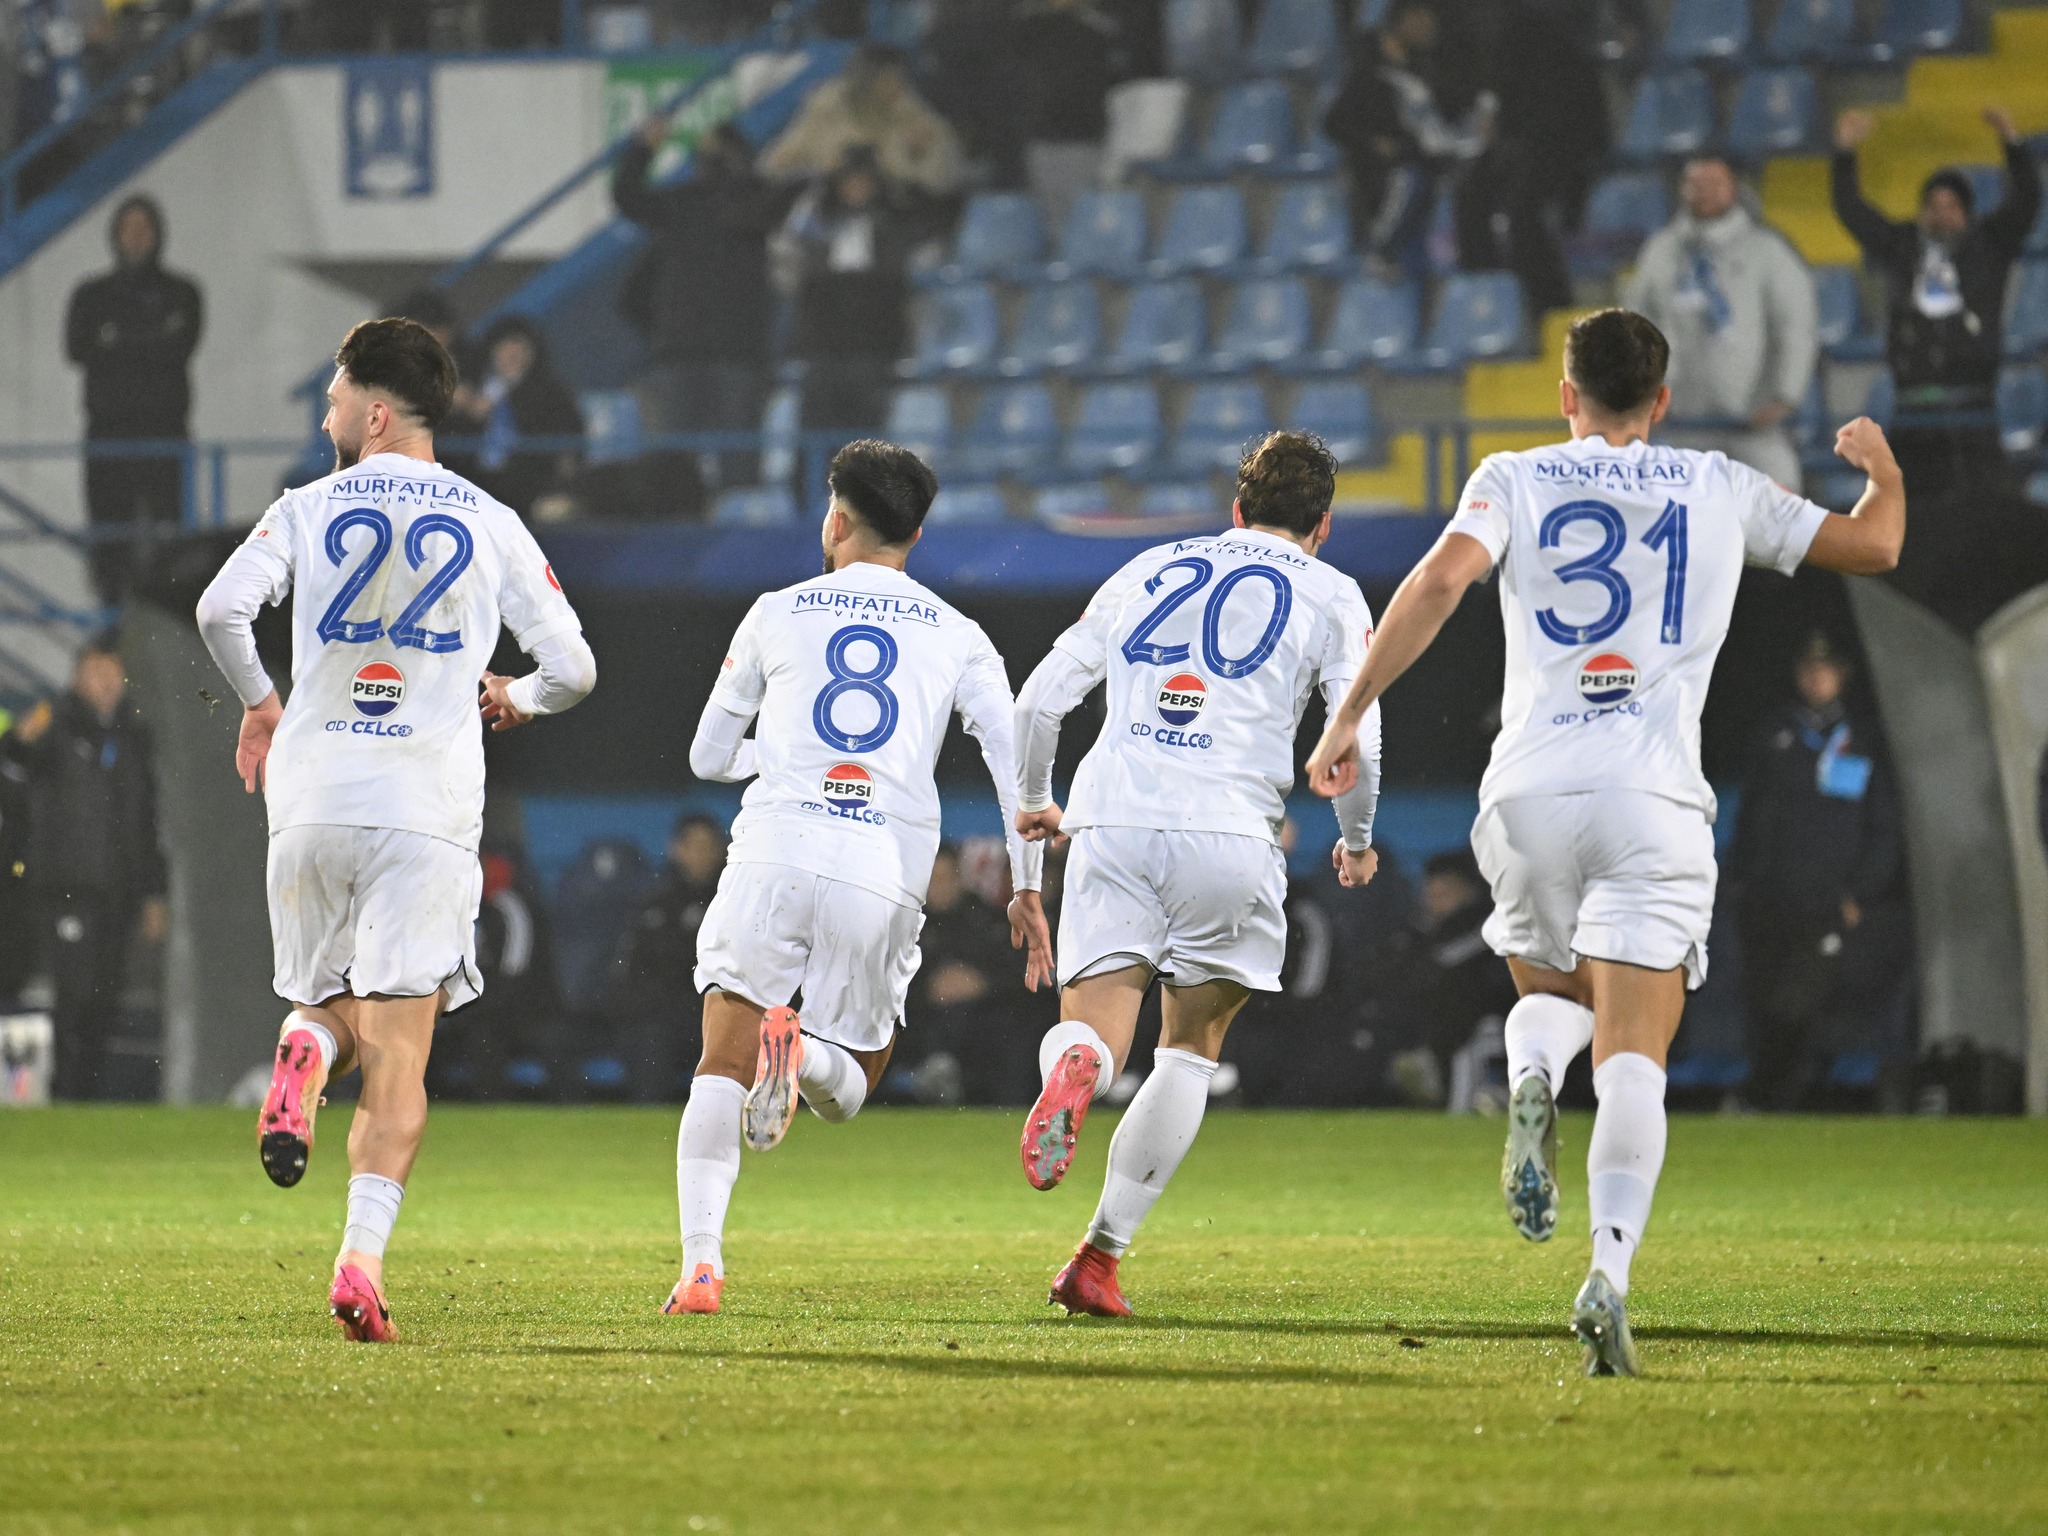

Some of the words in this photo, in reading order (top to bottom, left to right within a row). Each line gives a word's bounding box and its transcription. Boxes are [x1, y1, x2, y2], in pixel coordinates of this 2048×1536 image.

[1536, 463, 1687, 479] MURFATLAR
[333, 479, 477, 506] MURFATLAR
[1579, 480, 1647, 491] VINUL
[372, 496, 436, 508] VINUL
[1204, 547, 1264, 561] VINUL
[316, 507, 474, 654] 22
[1535, 498, 1688, 646] 31
[796, 592, 938, 623] MURFATLAR
[834, 610, 899, 623] VINUL
[1121, 557, 1293, 680] 20
[812, 624, 899, 754] 8
[1580, 674, 1636, 687] PEPSI
[353, 682, 403, 699] PEPSI
[1159, 691, 1205, 708] PEPSI
[351, 720, 413, 738] CELCO
[1155, 728, 1213, 749] CELCO
[824, 781, 872, 798] PEPSI
